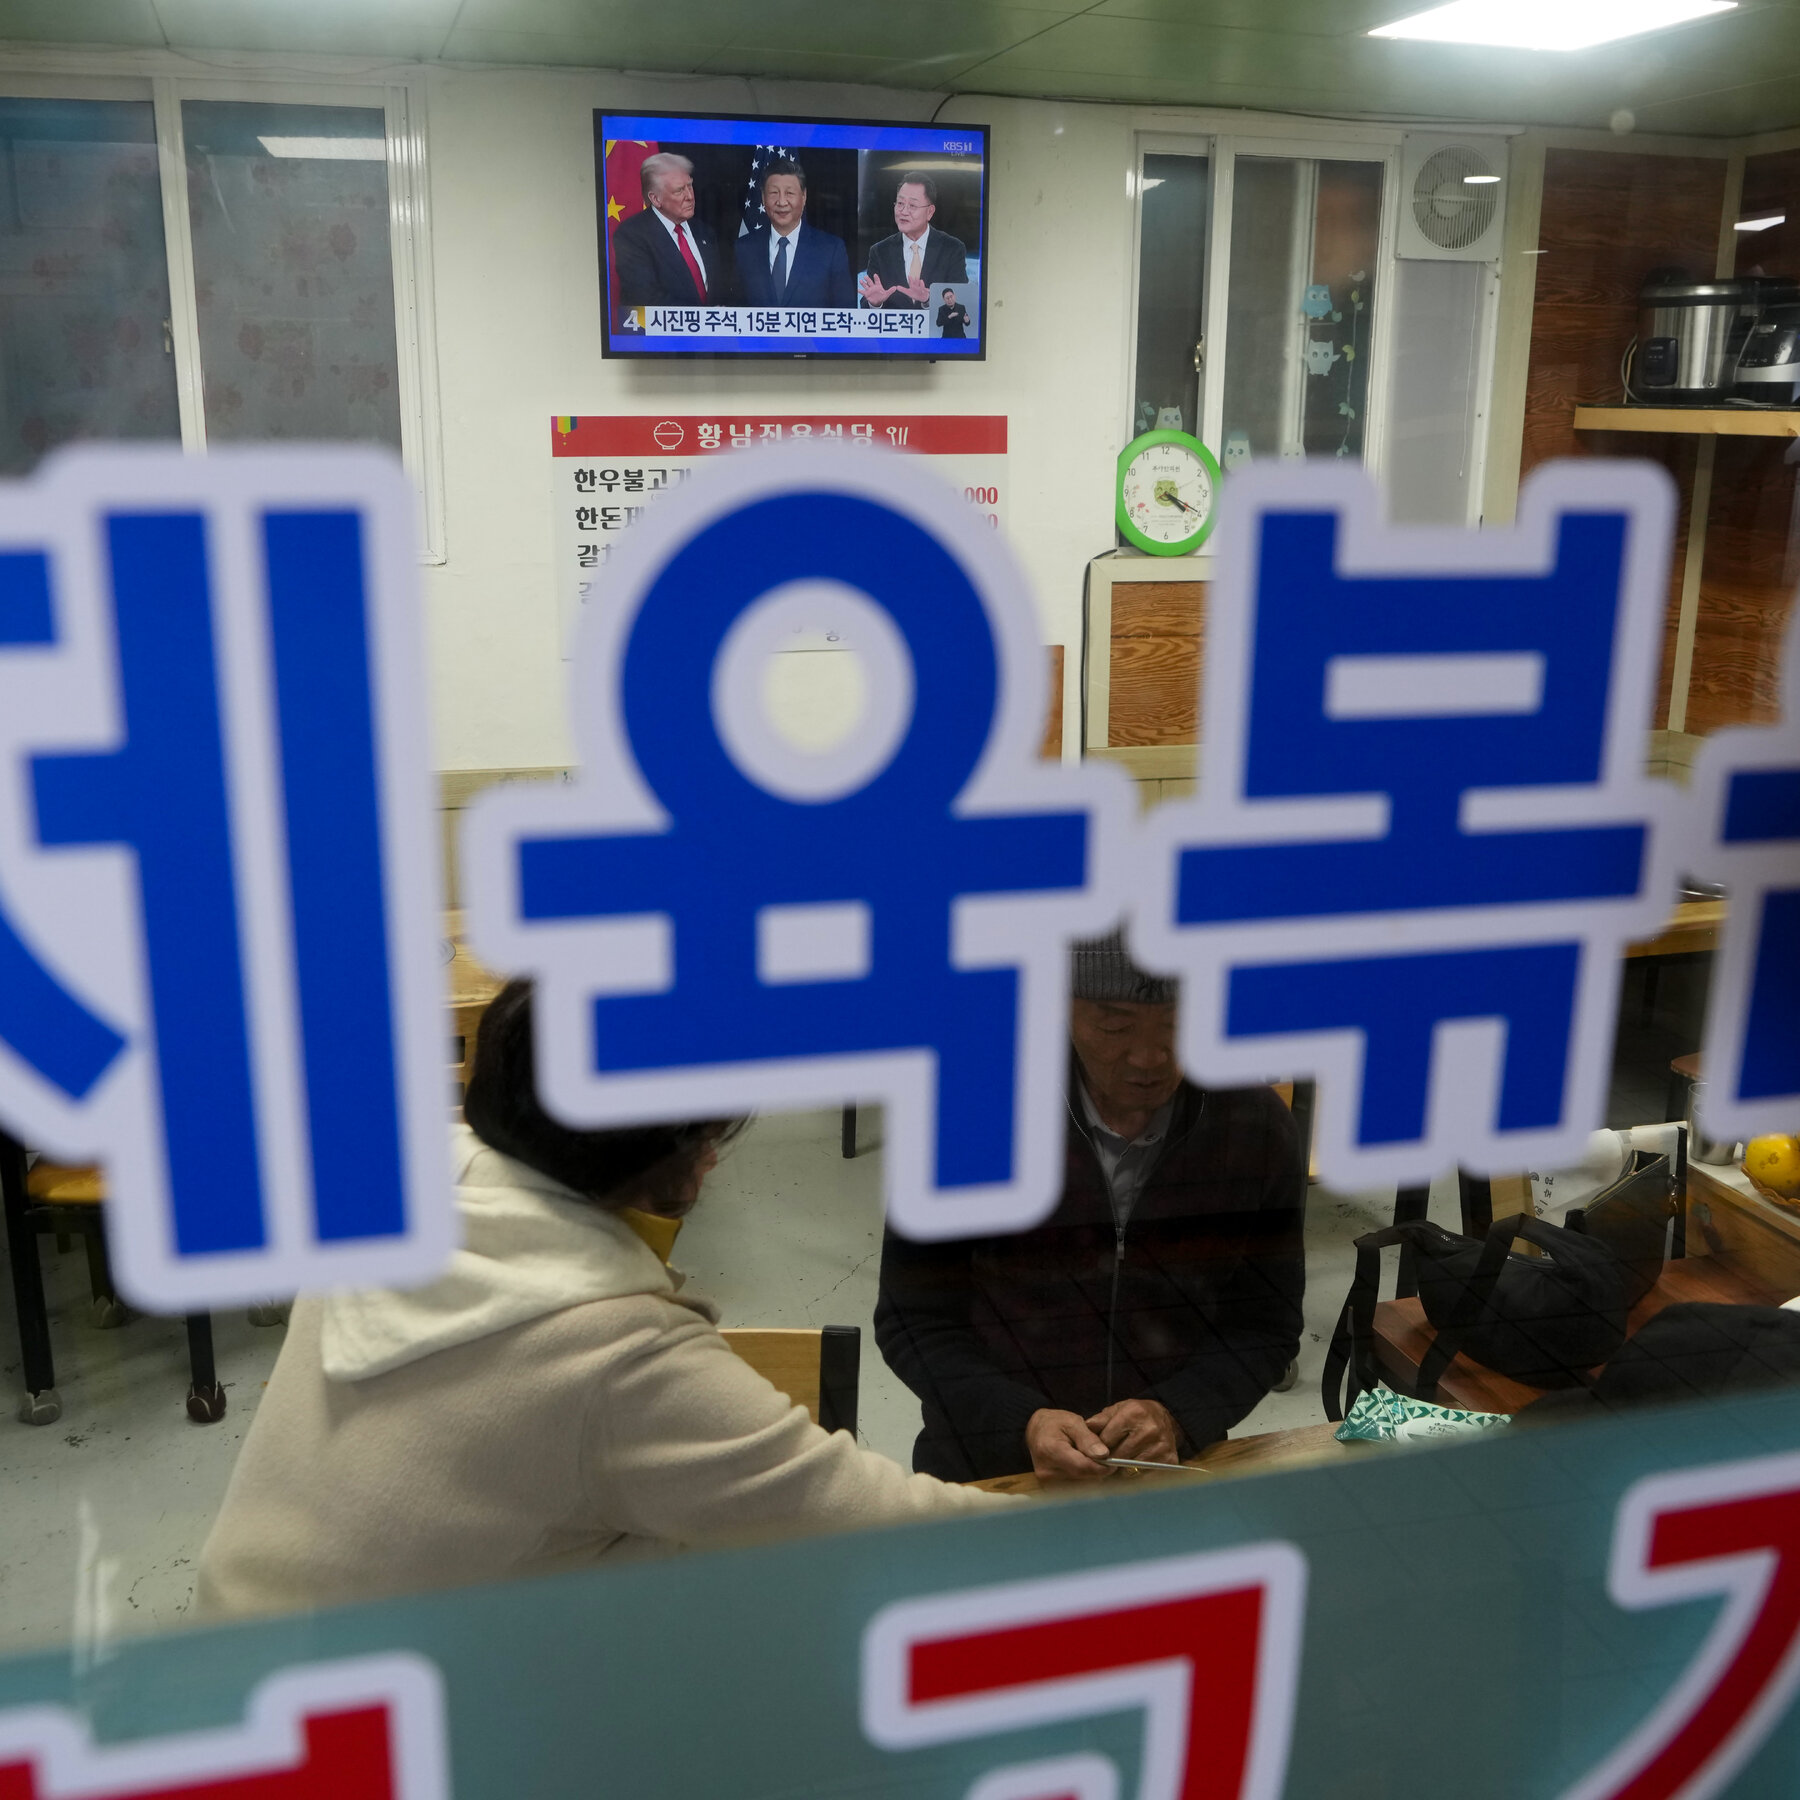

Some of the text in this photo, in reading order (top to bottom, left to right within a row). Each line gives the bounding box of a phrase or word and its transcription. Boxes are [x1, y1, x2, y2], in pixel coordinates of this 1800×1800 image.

[622, 310, 640, 332] 4
[650, 310, 701, 333] 시진핑
[705, 311, 742, 335] 주석,
[746, 312, 781, 333] 15분
[785, 312, 817, 333] 지연
[1161, 446, 1170, 455] 12
[1142, 452, 1150, 460] 11
[1185, 452, 1189, 460] 1
[1127, 468, 1136, 477] 10
[1196, 469, 1202, 477] 2
[1124, 488, 1129, 498] 9
[1202, 489, 1208, 498] 3
[1129, 509, 1135, 518] 8
[1143, 525, 1149, 533] 7
[1184, 525, 1190, 533] 5
[1163, 531, 1169, 540] 6
